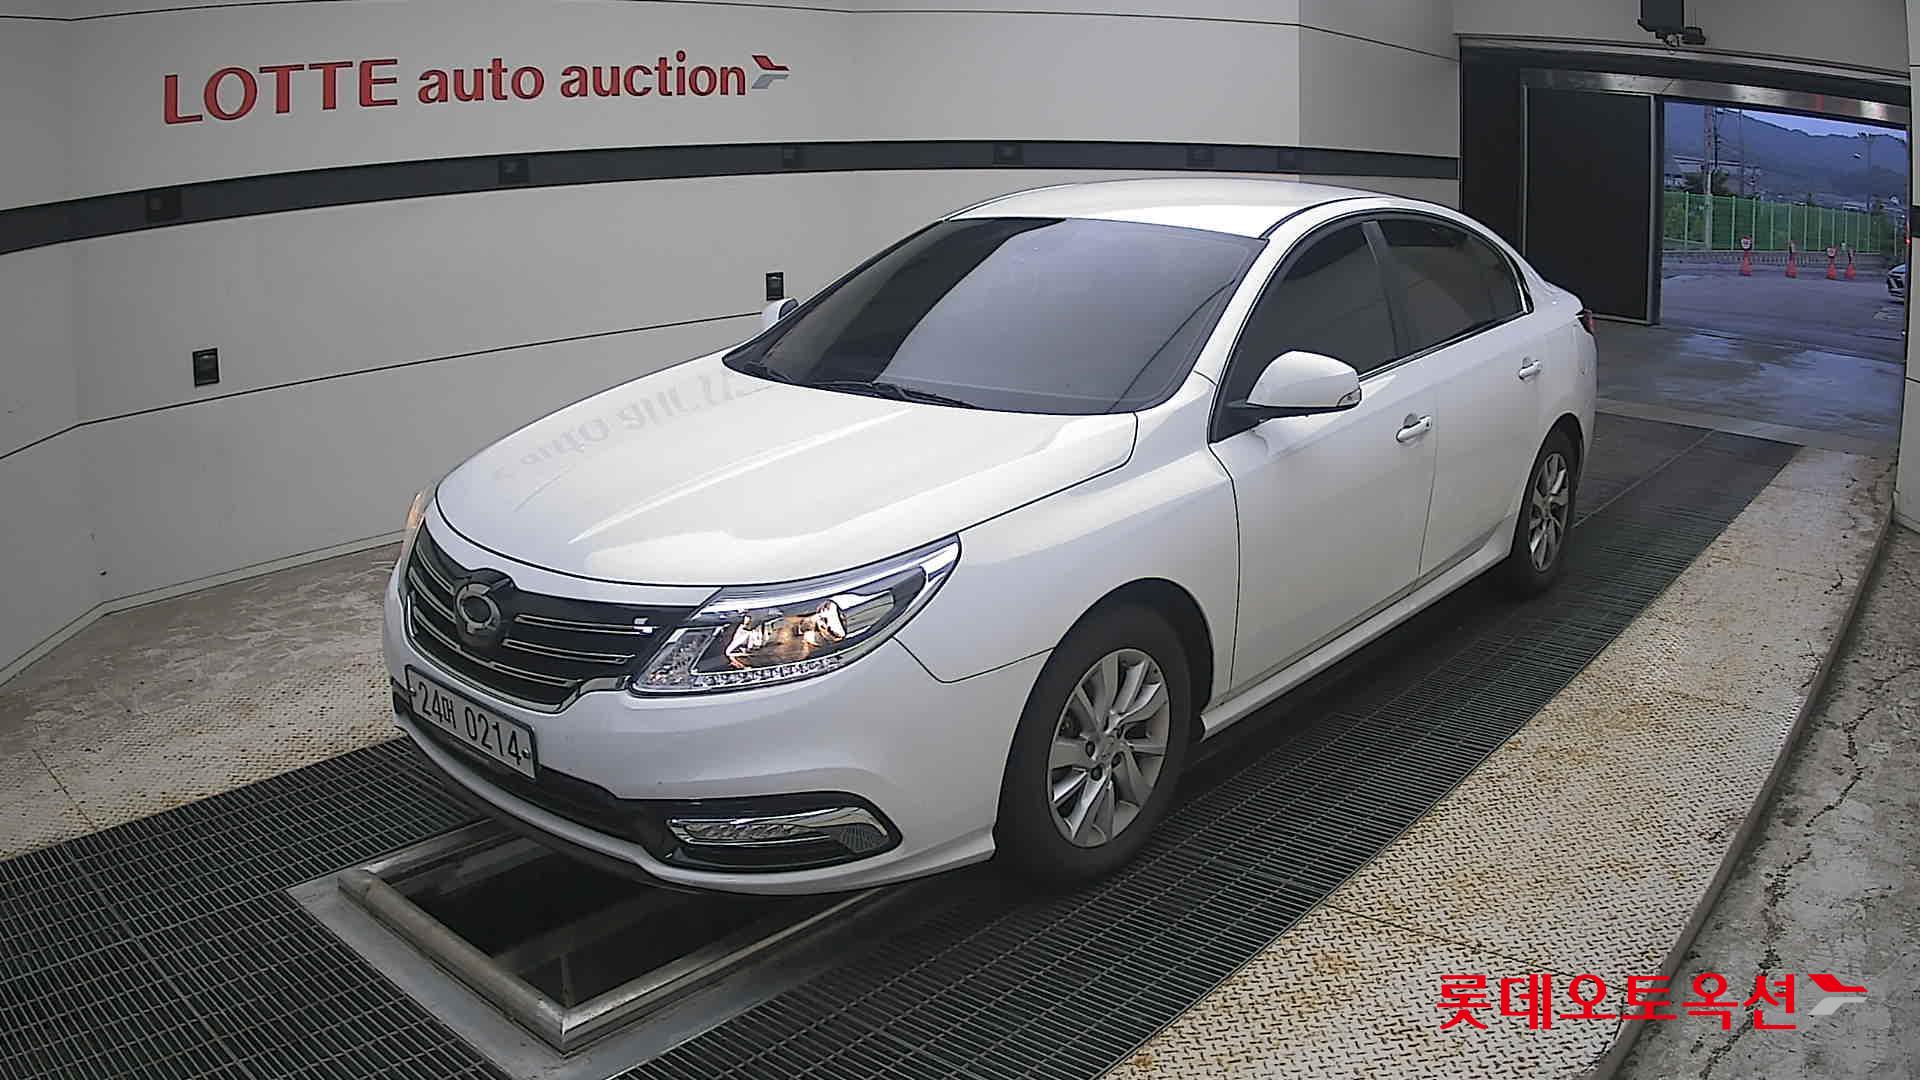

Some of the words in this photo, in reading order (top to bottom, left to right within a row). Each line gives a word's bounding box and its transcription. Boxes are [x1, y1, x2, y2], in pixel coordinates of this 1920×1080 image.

[163, 58, 399, 124] LOTTE
[418, 58, 545, 104] auto
[560, 51, 747, 98] auction
[464, 706, 522, 766] 0214
